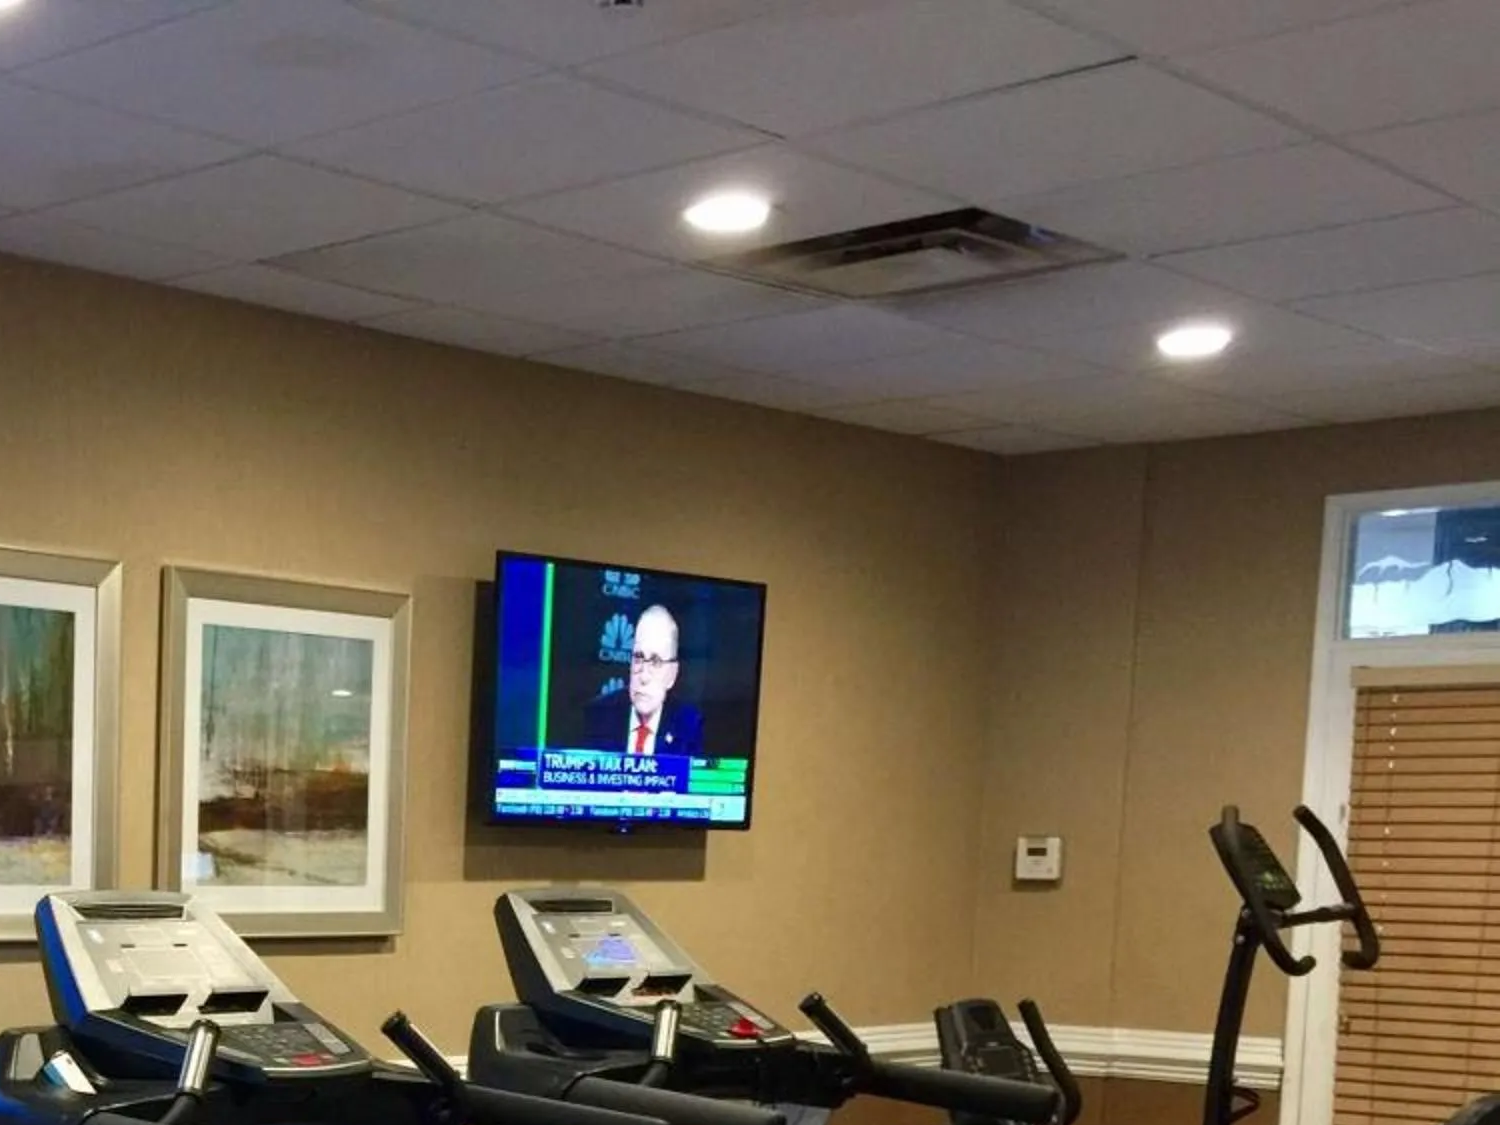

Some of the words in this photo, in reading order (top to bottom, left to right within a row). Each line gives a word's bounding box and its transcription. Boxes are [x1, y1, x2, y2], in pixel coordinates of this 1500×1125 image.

[599, 756, 622, 771] TAX
[623, 757, 658, 773] PLAN:
[543, 771, 587, 785] BUSINESS
[597, 773, 642, 787] INVESTING
[643, 775, 677, 788] IMPACT
